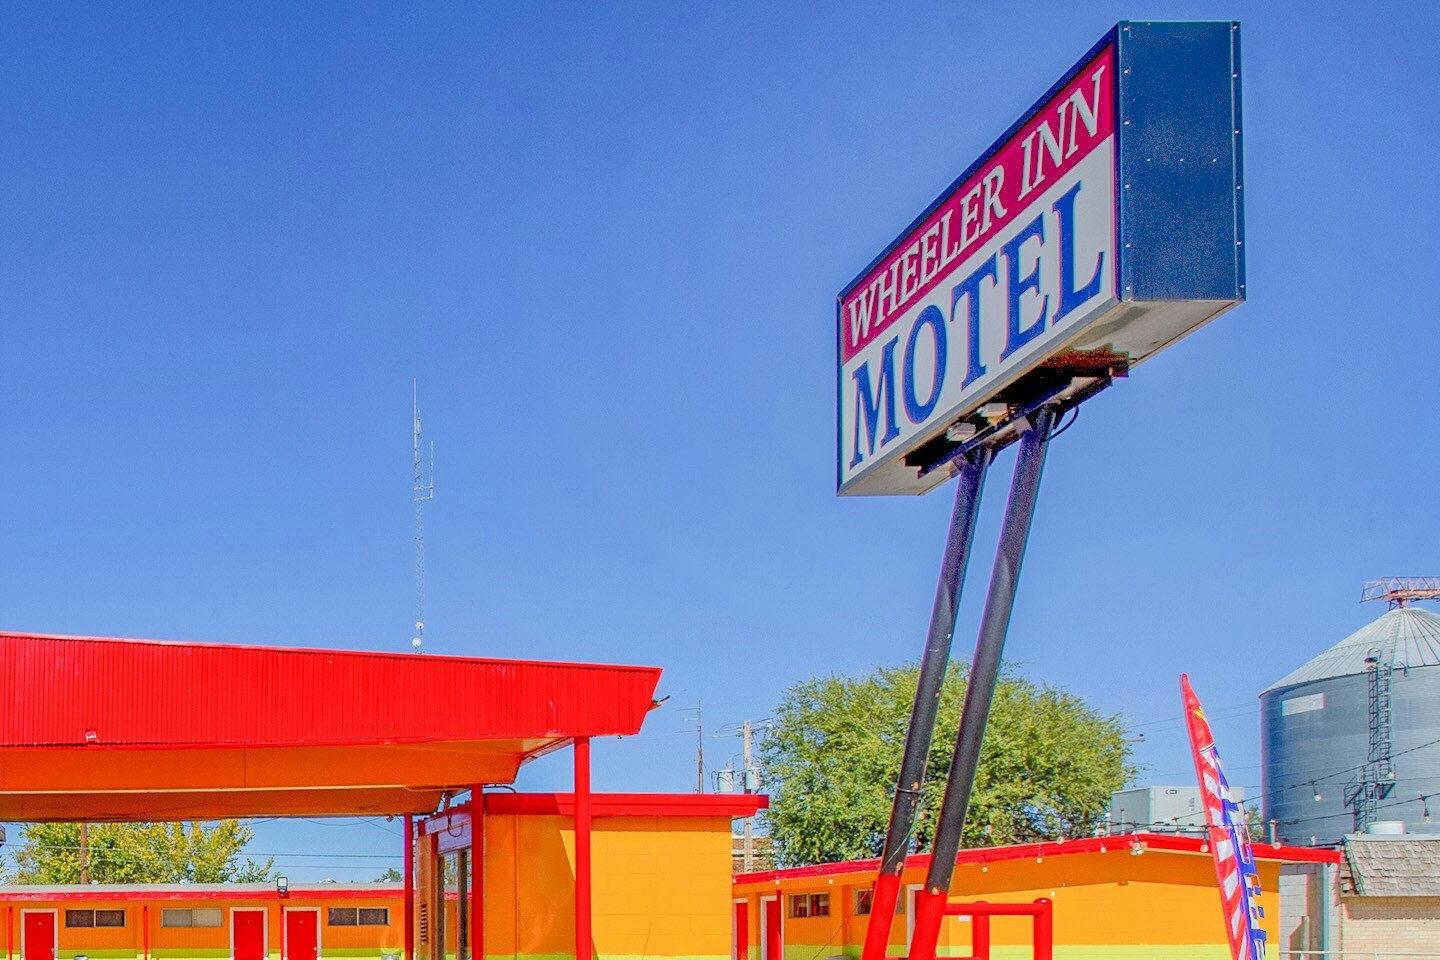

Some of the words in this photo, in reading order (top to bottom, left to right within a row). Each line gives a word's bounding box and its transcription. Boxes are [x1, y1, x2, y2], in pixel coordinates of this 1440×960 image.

[848, 164, 1008, 348] WHEELER
[1017, 64, 1106, 202] INN
[849, 179, 1105, 471] MOTEL
